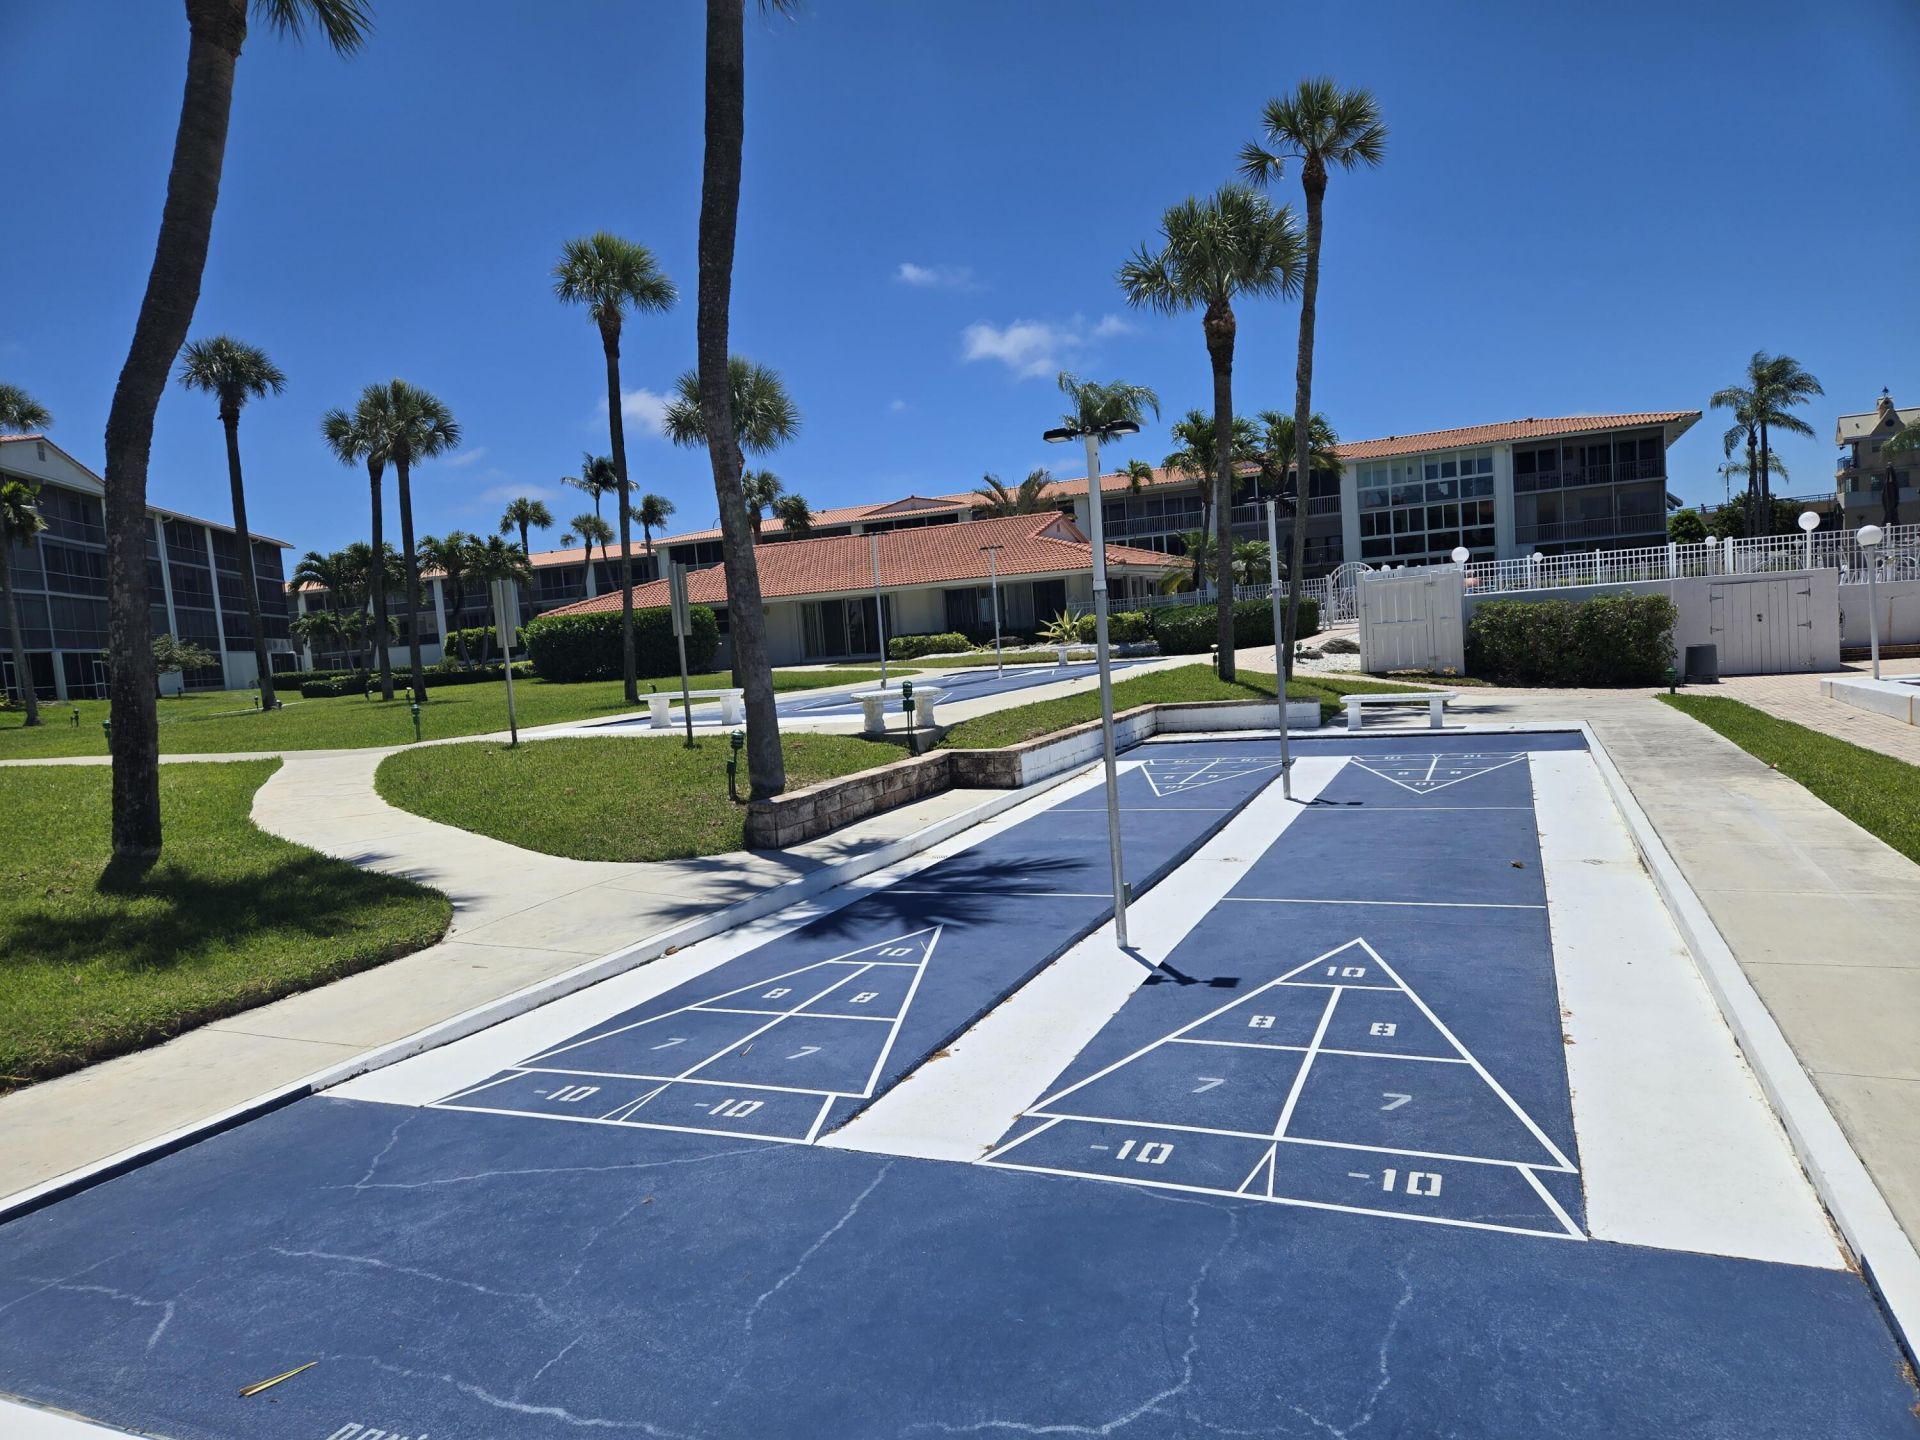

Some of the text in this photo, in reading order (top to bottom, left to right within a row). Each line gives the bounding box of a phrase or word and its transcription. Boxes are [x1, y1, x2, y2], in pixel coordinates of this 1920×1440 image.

[877, 947, 912, 957] 10
[1327, 967, 1365, 977] 10
[762, 988, 792, 998] 8
[849, 992, 879, 1002] 8
[1248, 1016, 1275, 1028] 8
[1370, 1023, 1396, 1036] 8
[651, 1038, 686, 1049] 7
[786, 1046, 821, 1059] 7
[1192, 1077, 1225, 1092] 7
[1381, 1093, 1411, 1110] 7
